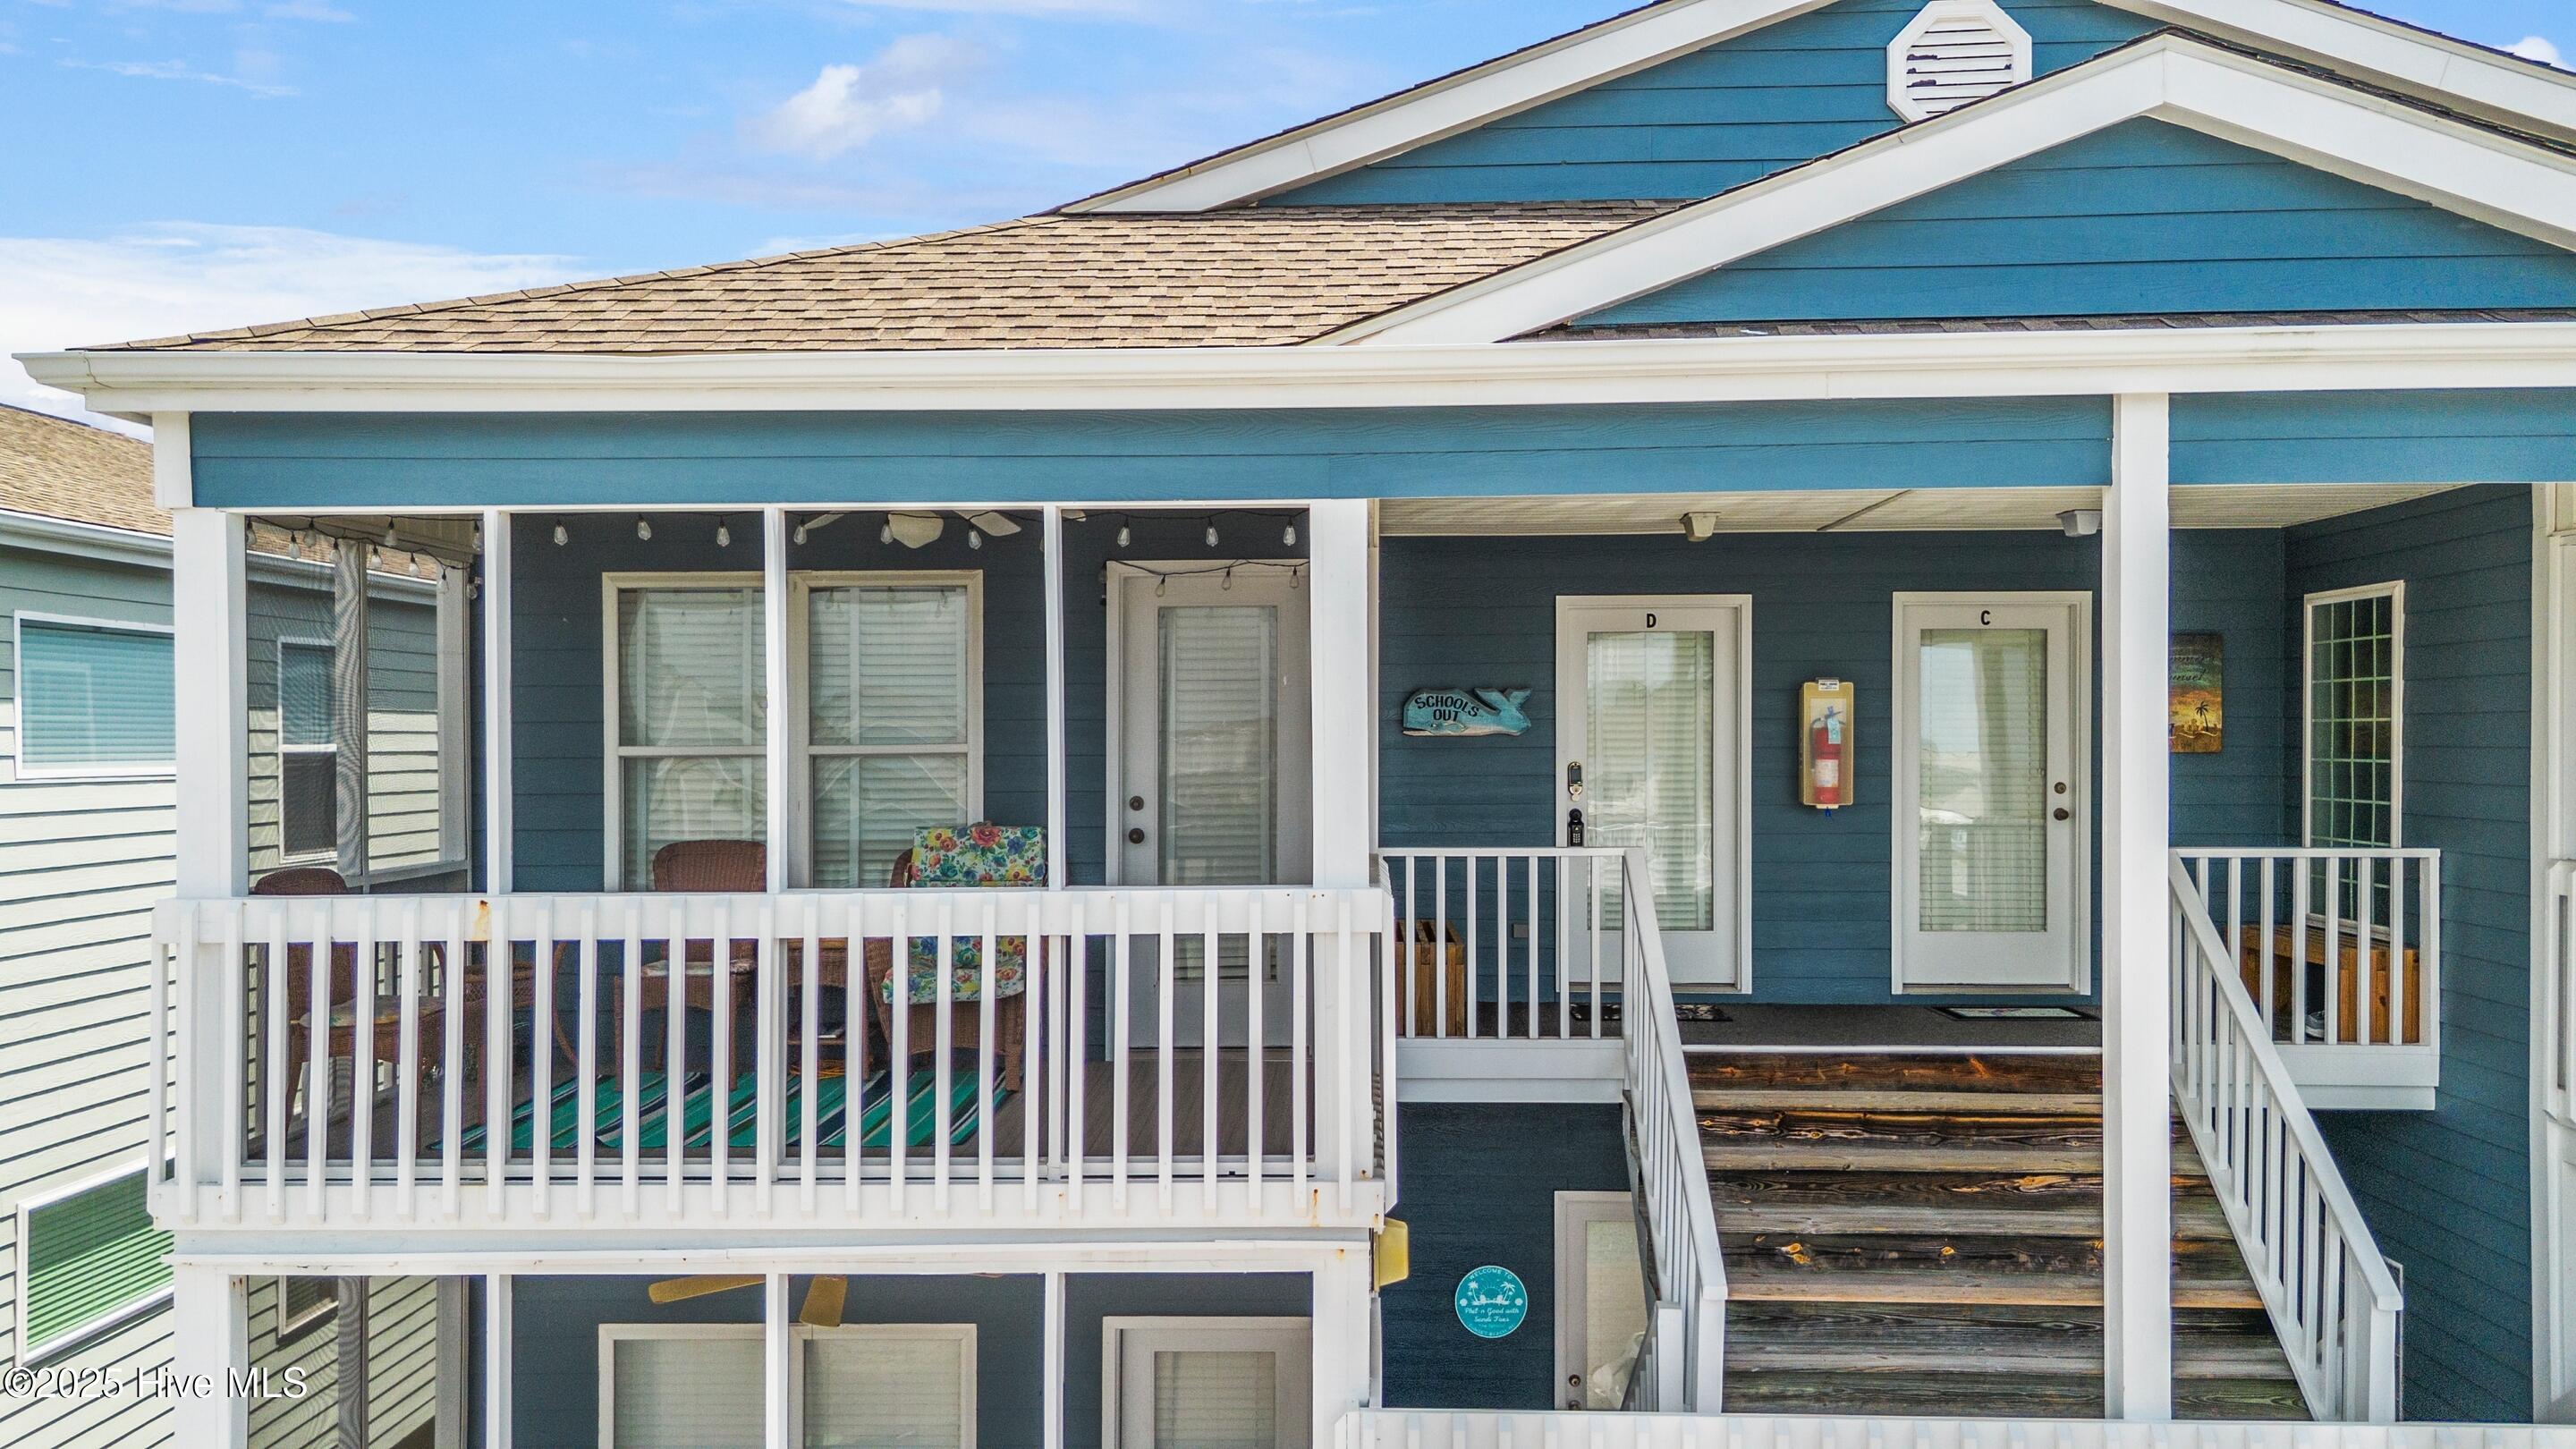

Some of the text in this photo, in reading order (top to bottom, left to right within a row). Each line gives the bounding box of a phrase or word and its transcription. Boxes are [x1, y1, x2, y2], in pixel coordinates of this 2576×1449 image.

[1647, 614, 1657, 628] D
[1981, 610, 1990, 625] C
[1433, 708, 1461, 722] OUT
[1470, 1268, 1502, 1280] WELCOME
